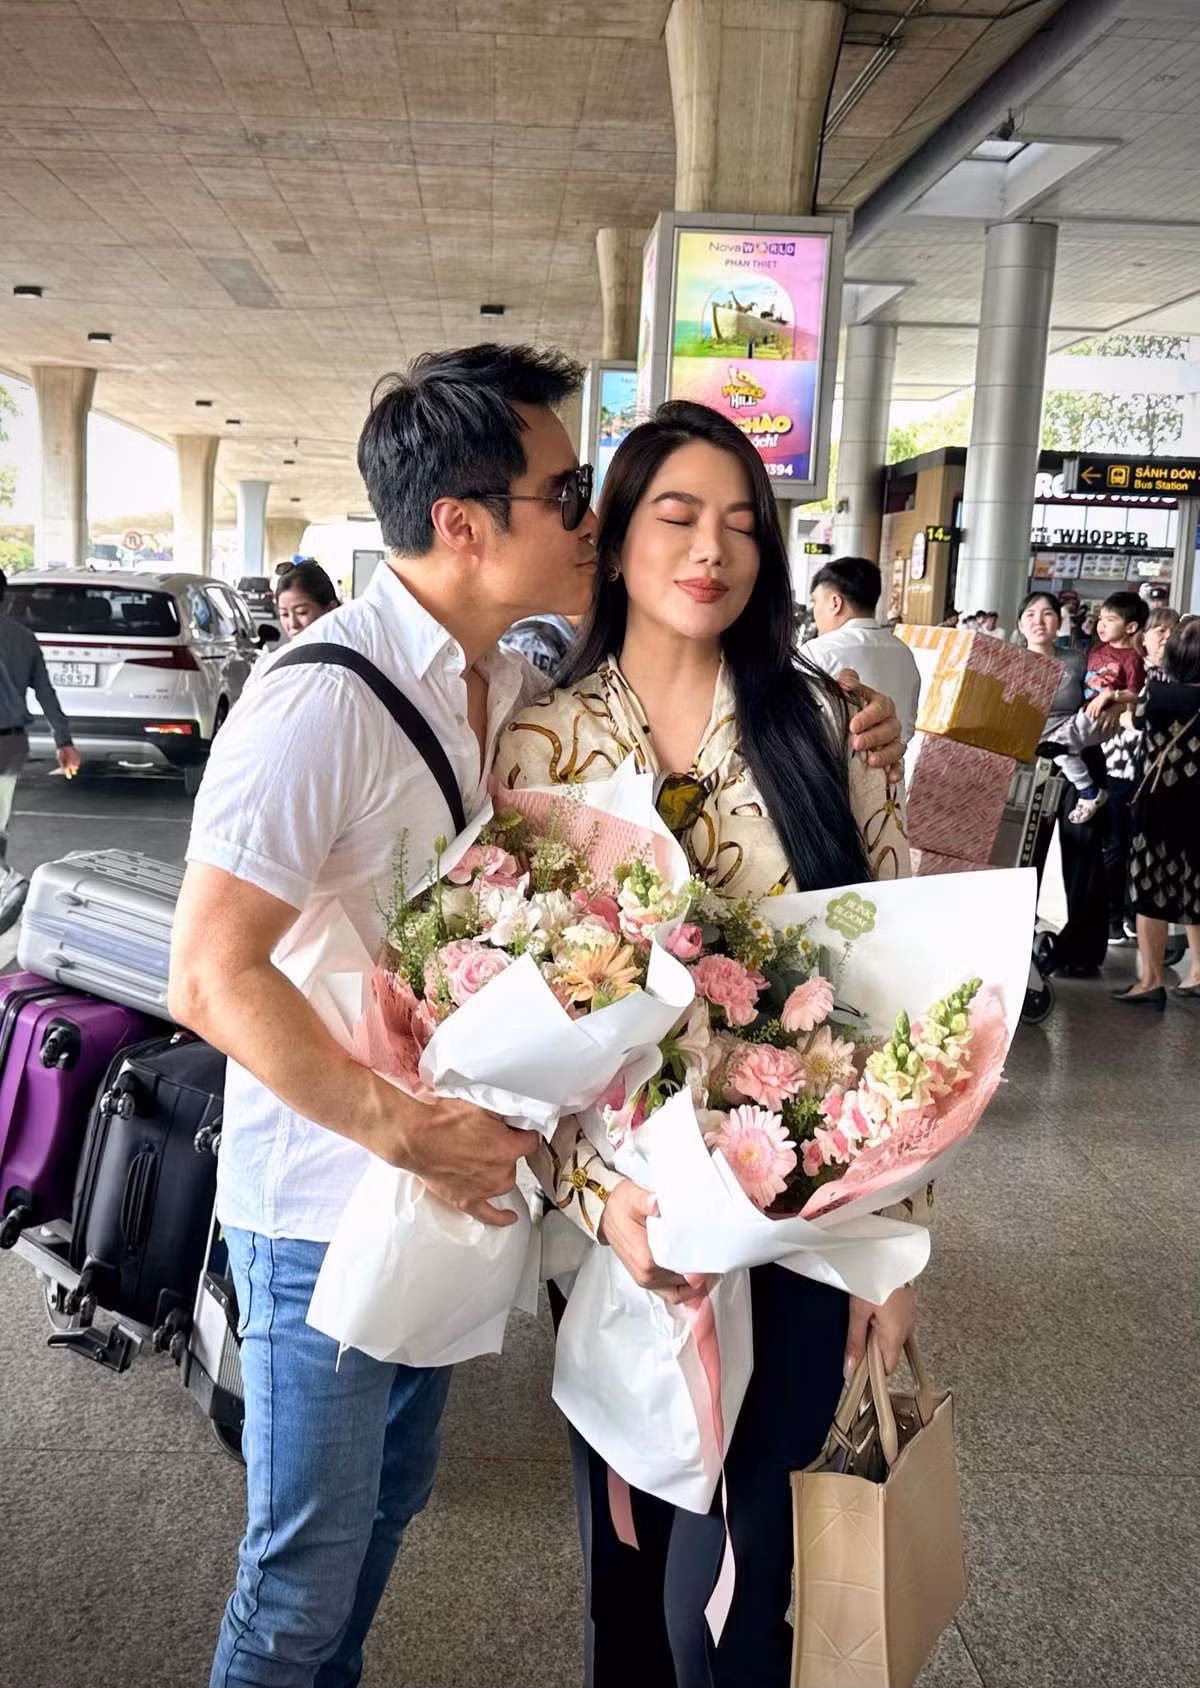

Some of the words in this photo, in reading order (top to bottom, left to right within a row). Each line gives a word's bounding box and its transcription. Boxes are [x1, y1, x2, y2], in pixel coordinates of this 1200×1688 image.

[725, 258, 750, 268] PHAN
[1134, 479, 1153, 490] Bus
[1155, 480, 1188, 491] Station
[1053, 528, 1149, 548] WHOPPER
